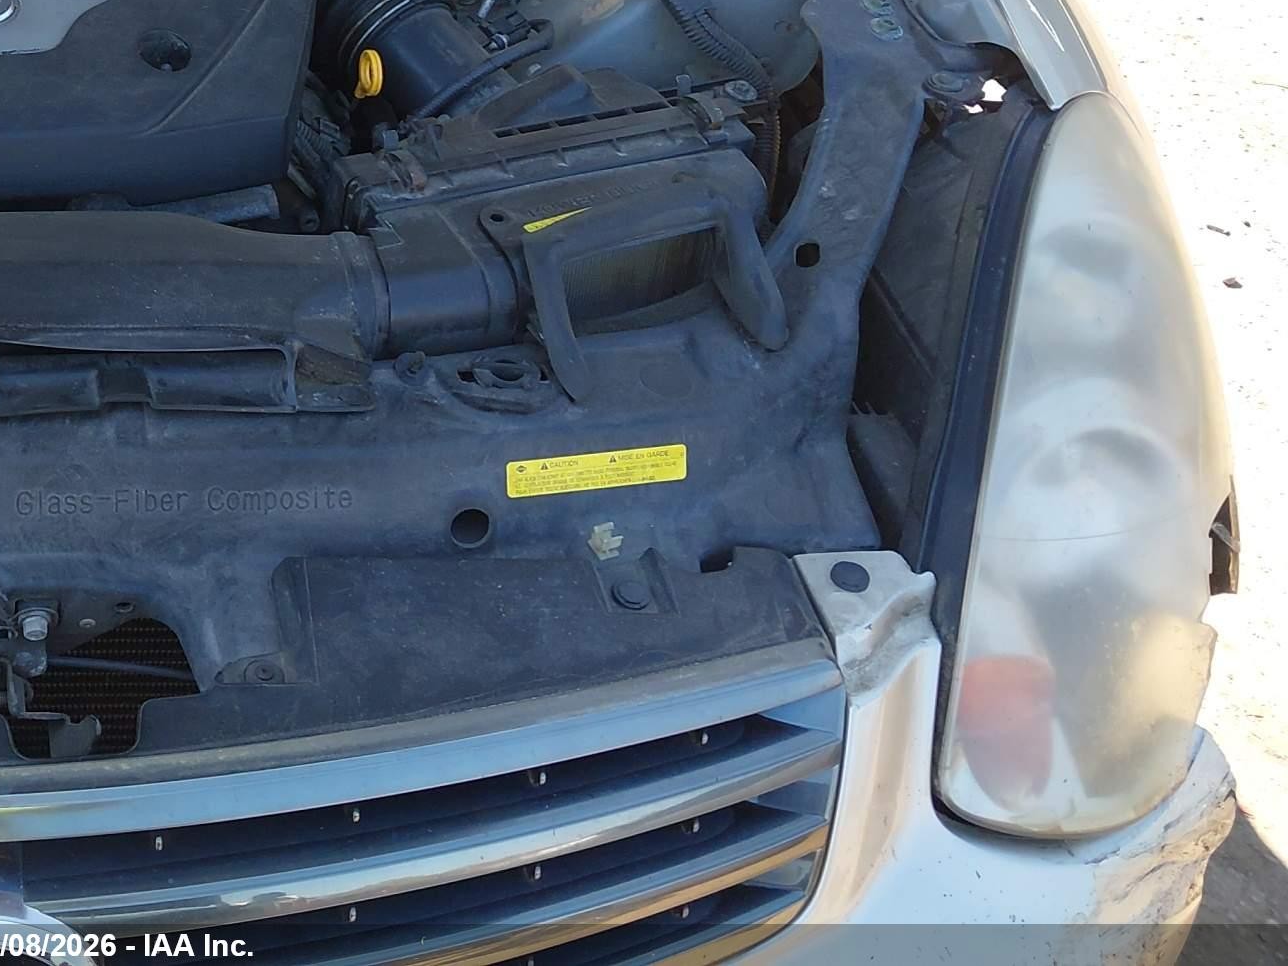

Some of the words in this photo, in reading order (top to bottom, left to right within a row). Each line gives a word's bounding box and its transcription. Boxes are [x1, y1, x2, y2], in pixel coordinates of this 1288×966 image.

[549, 460, 579, 469] CAUTION
[15, 489, 190, 516] Glass-Fiber
[207, 486, 353, 515] Composite
